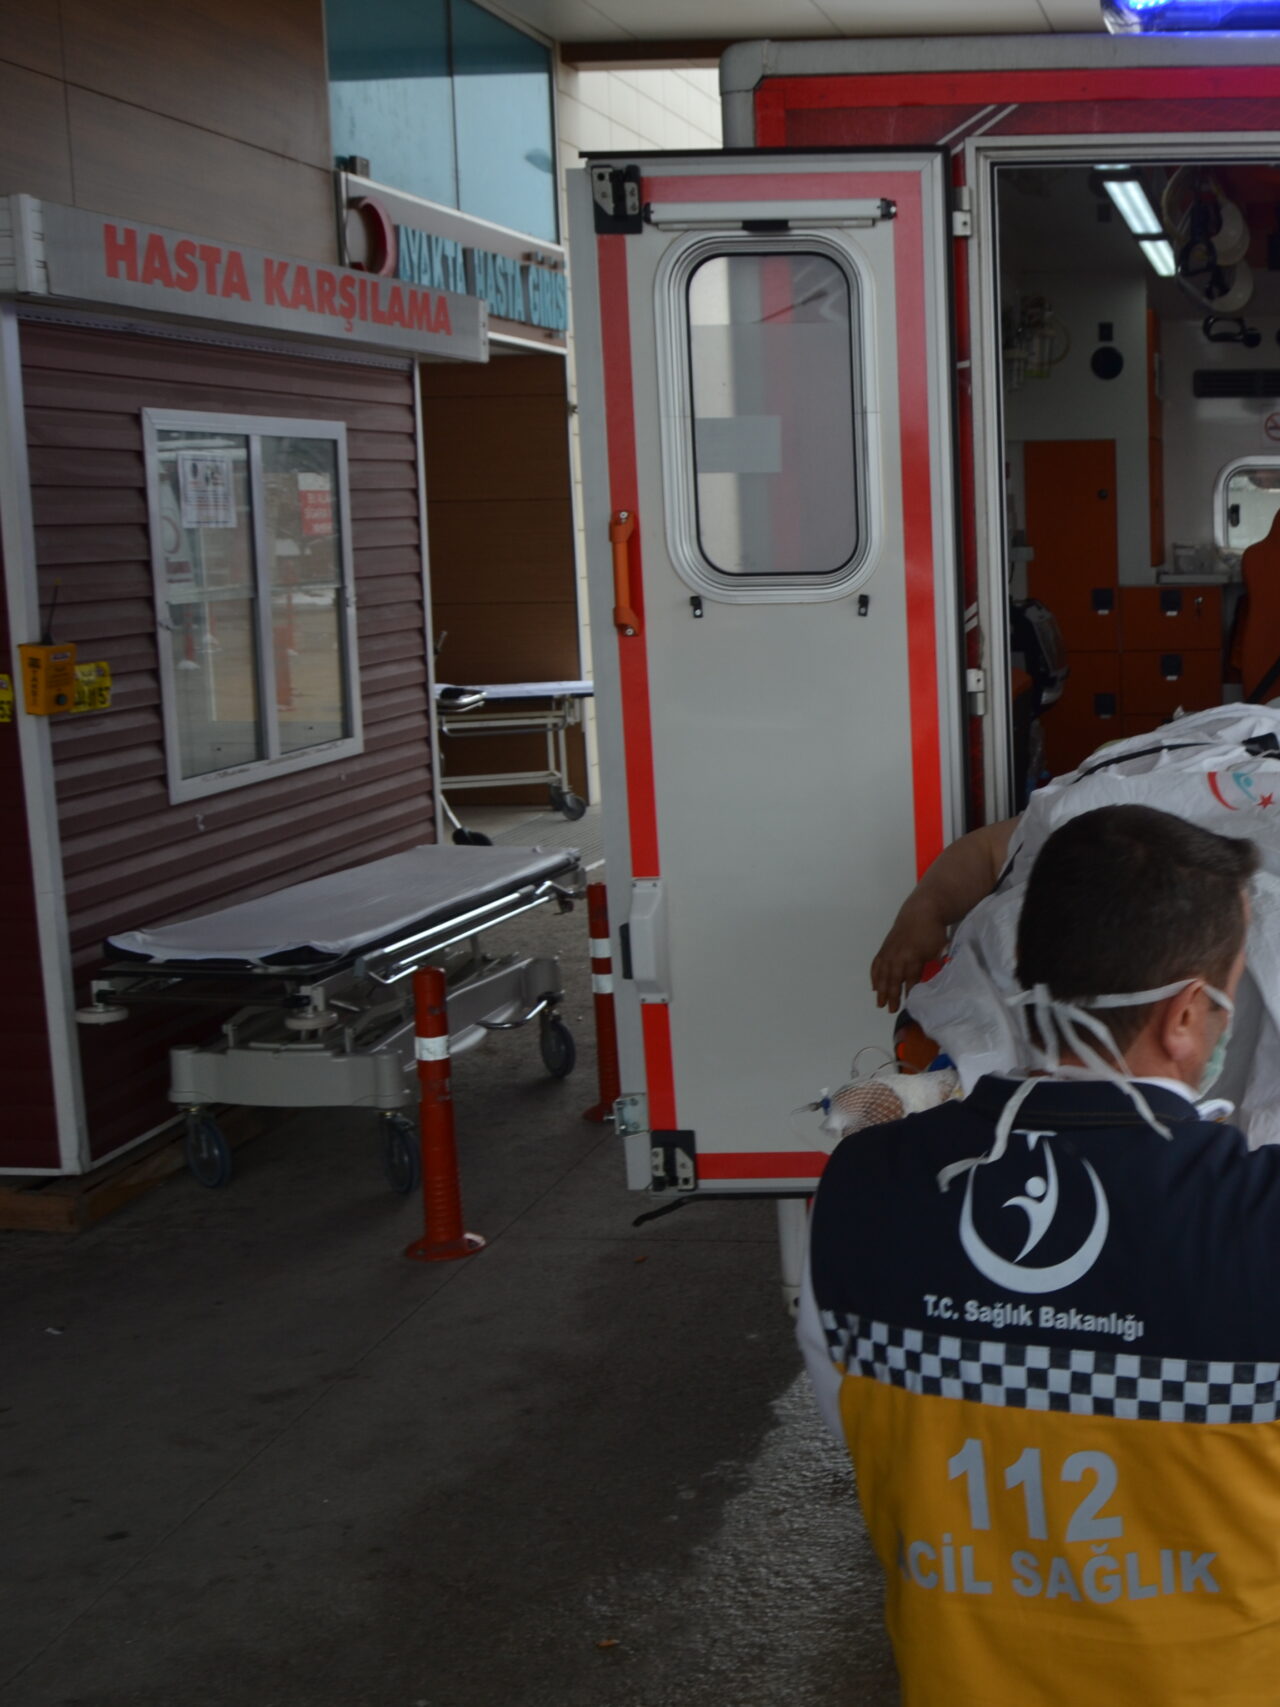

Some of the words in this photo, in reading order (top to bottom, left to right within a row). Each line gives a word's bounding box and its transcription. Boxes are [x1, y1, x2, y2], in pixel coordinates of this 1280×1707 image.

[104, 223, 252, 301] HASTA
[263, 258, 453, 335] KARŞILAMA
[398, 224, 467, 296] AYAKTA
[473, 248, 525, 322] HASTA
[923, 1294, 959, 1320] T.C.
[964, 1299, 1032, 1329] Sağlık
[1038, 1306, 1144, 1341] Bakanlığı
[947, 1437, 1124, 1543] 112
[1010, 1543, 1220, 1603] SAĞLIK
